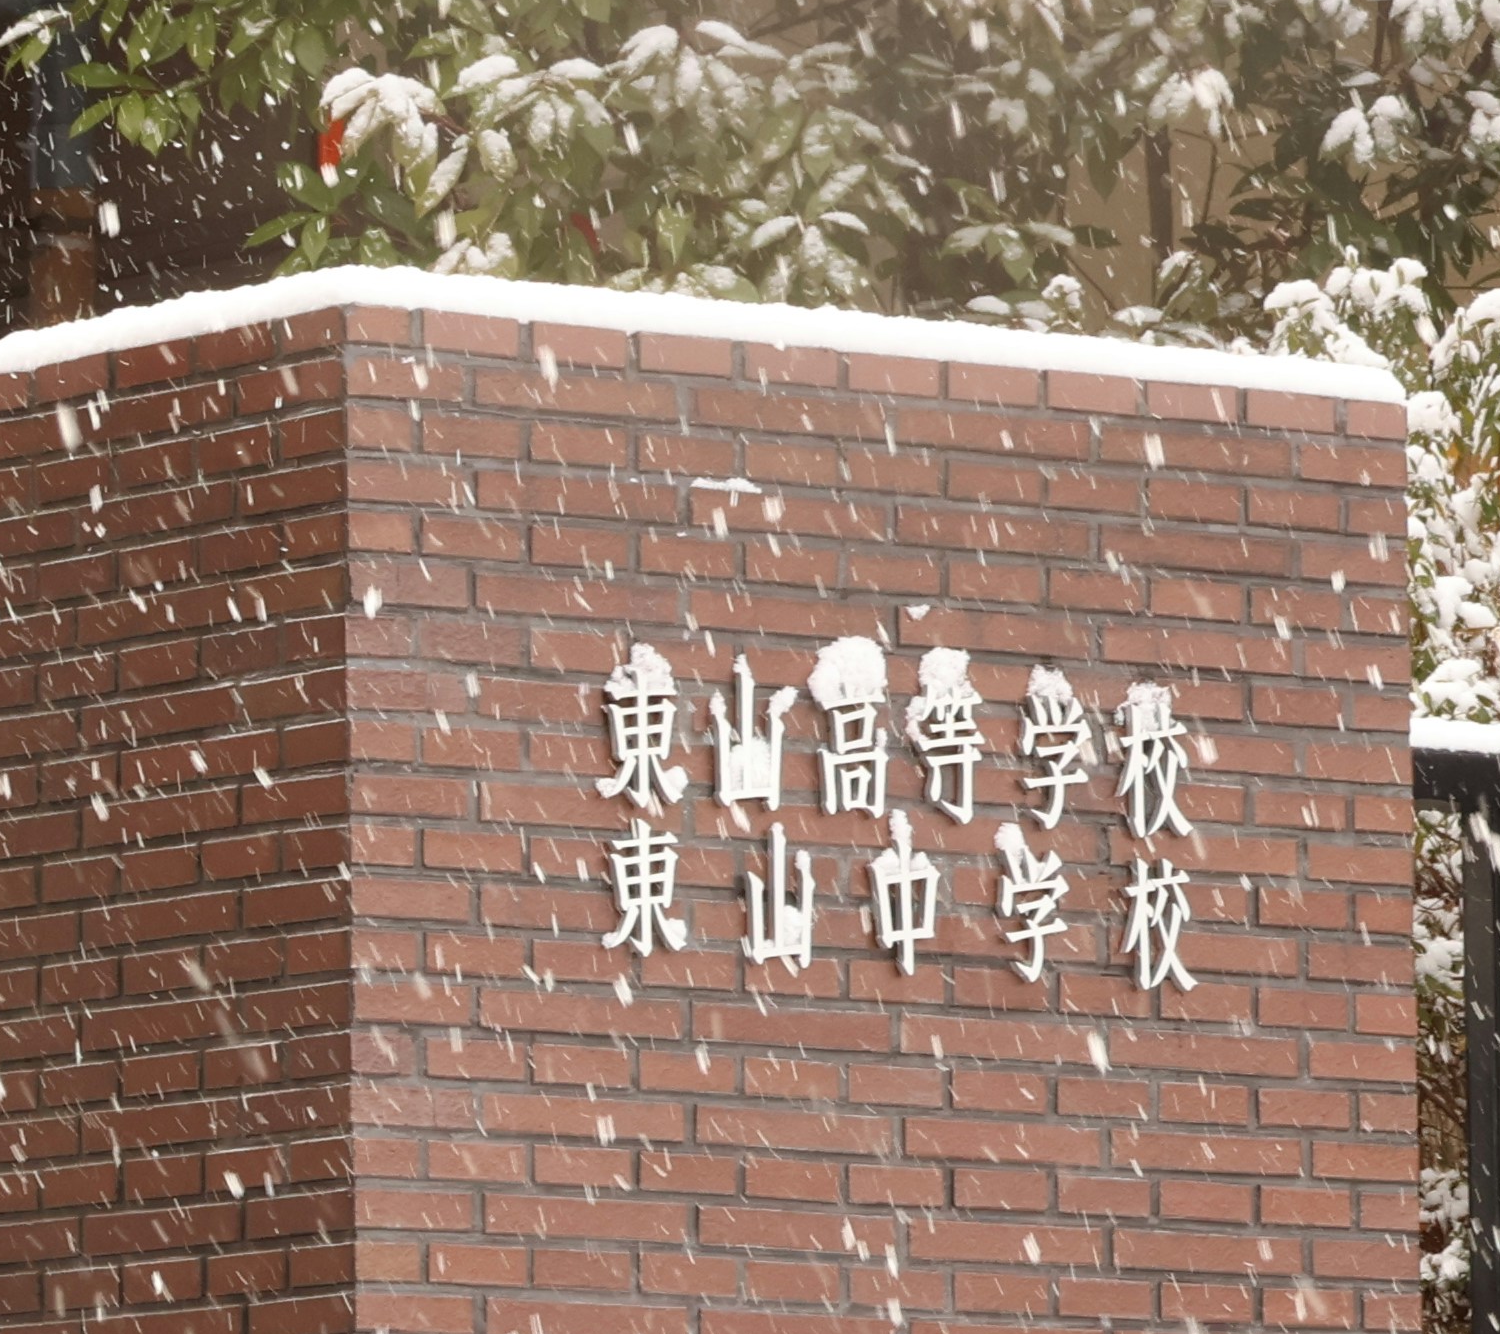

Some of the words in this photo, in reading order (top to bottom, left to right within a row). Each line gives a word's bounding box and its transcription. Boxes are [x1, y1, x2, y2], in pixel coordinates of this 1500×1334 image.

[603, 655, 1195, 838] 東山高等学校
[604, 817, 1198, 991] 東山中学校
